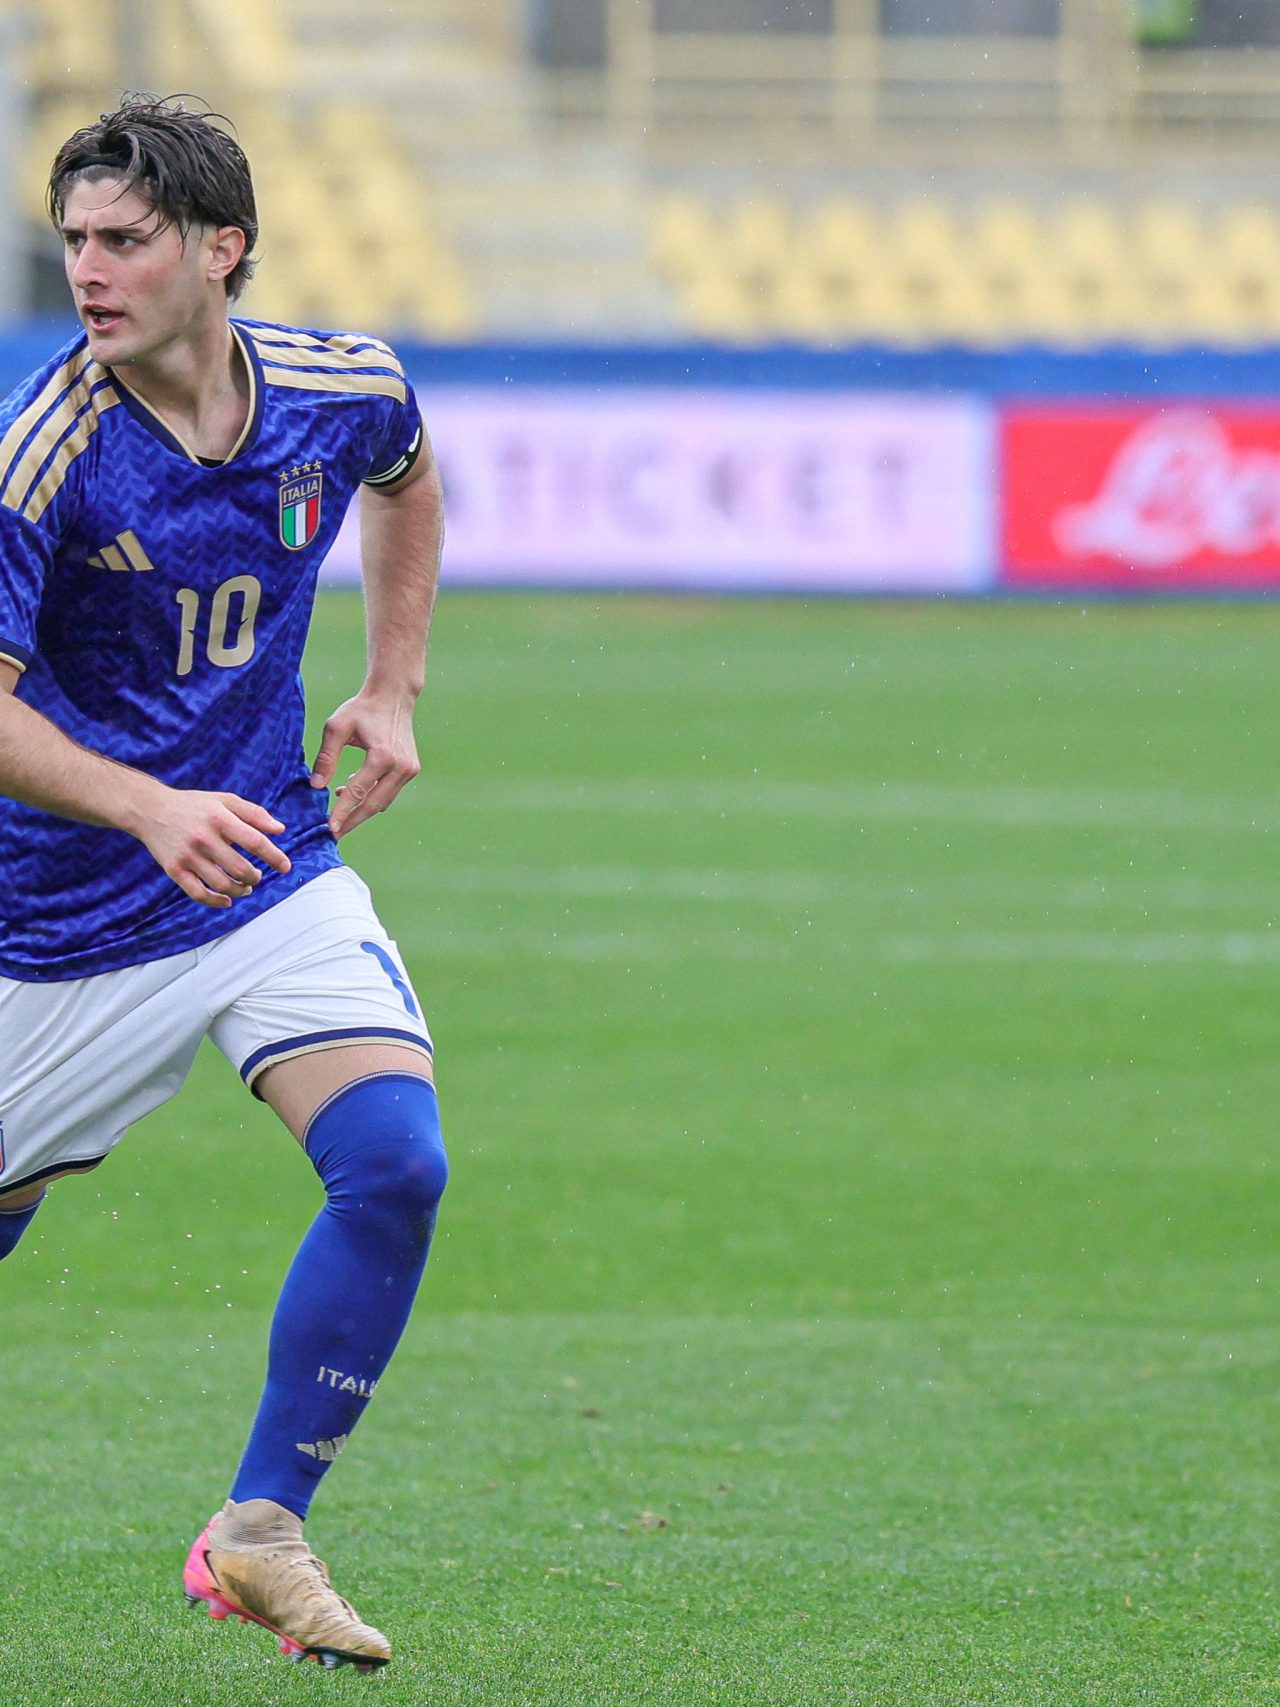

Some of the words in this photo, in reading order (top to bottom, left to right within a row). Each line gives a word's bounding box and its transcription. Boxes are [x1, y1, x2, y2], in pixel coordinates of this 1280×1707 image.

[283, 479, 318, 503] ITALIA
[176, 574, 261, 676] 10
[316, 1366, 378, 1398] ITALI
